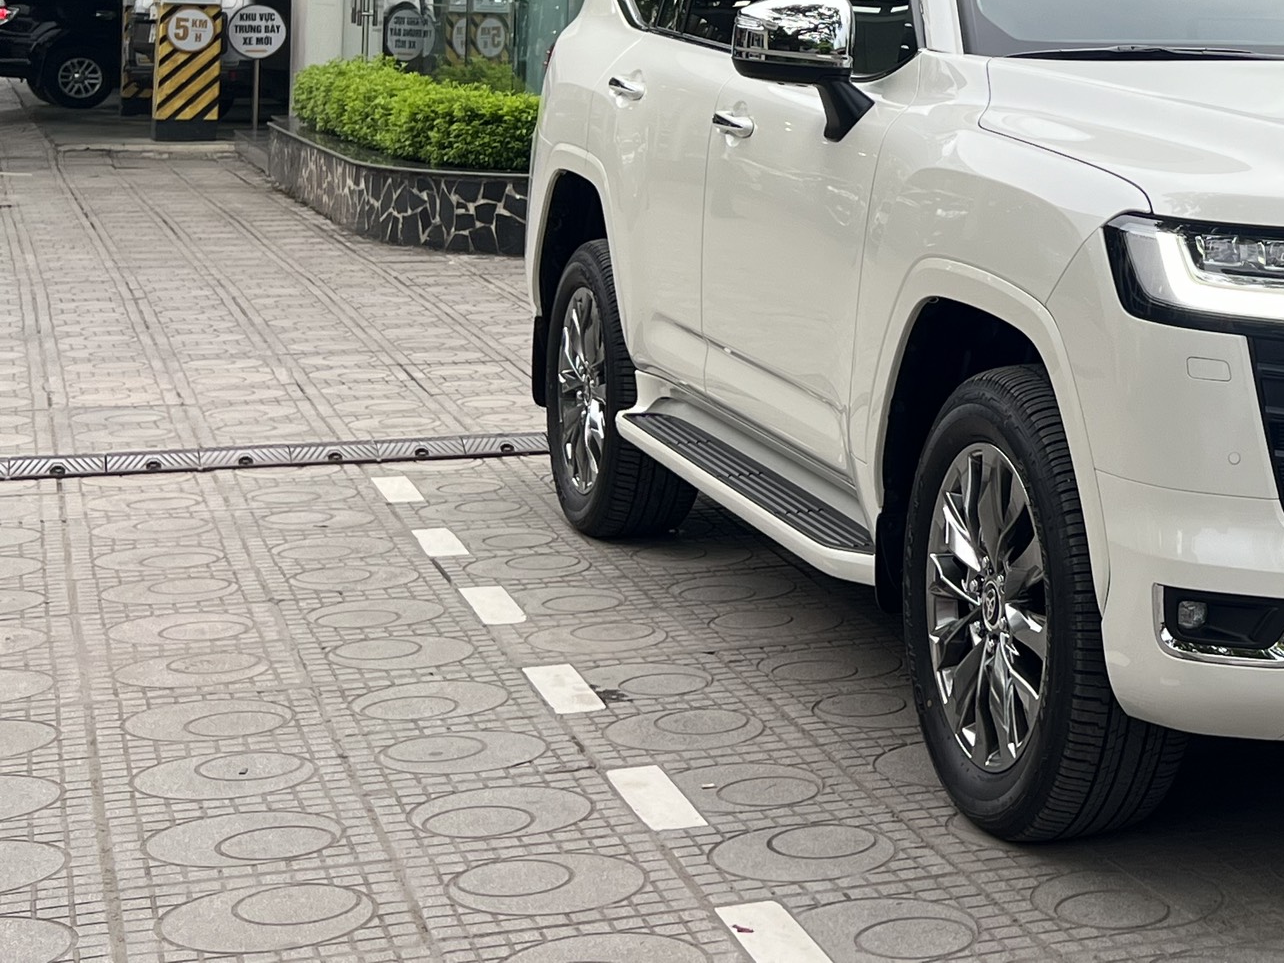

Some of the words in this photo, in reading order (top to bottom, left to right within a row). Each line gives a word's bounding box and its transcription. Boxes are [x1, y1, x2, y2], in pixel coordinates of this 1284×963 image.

[240, 13, 257, 21] KHU
[258, 13, 275, 23] VỰC
[174, 17, 189, 41] 5
[192, 19, 208, 29] KM
[234, 25, 262, 34] TRƯNG
[195, 33, 202, 42] H
[242, 37, 253, 45] XE
[255, 35, 272, 45] MỚI
